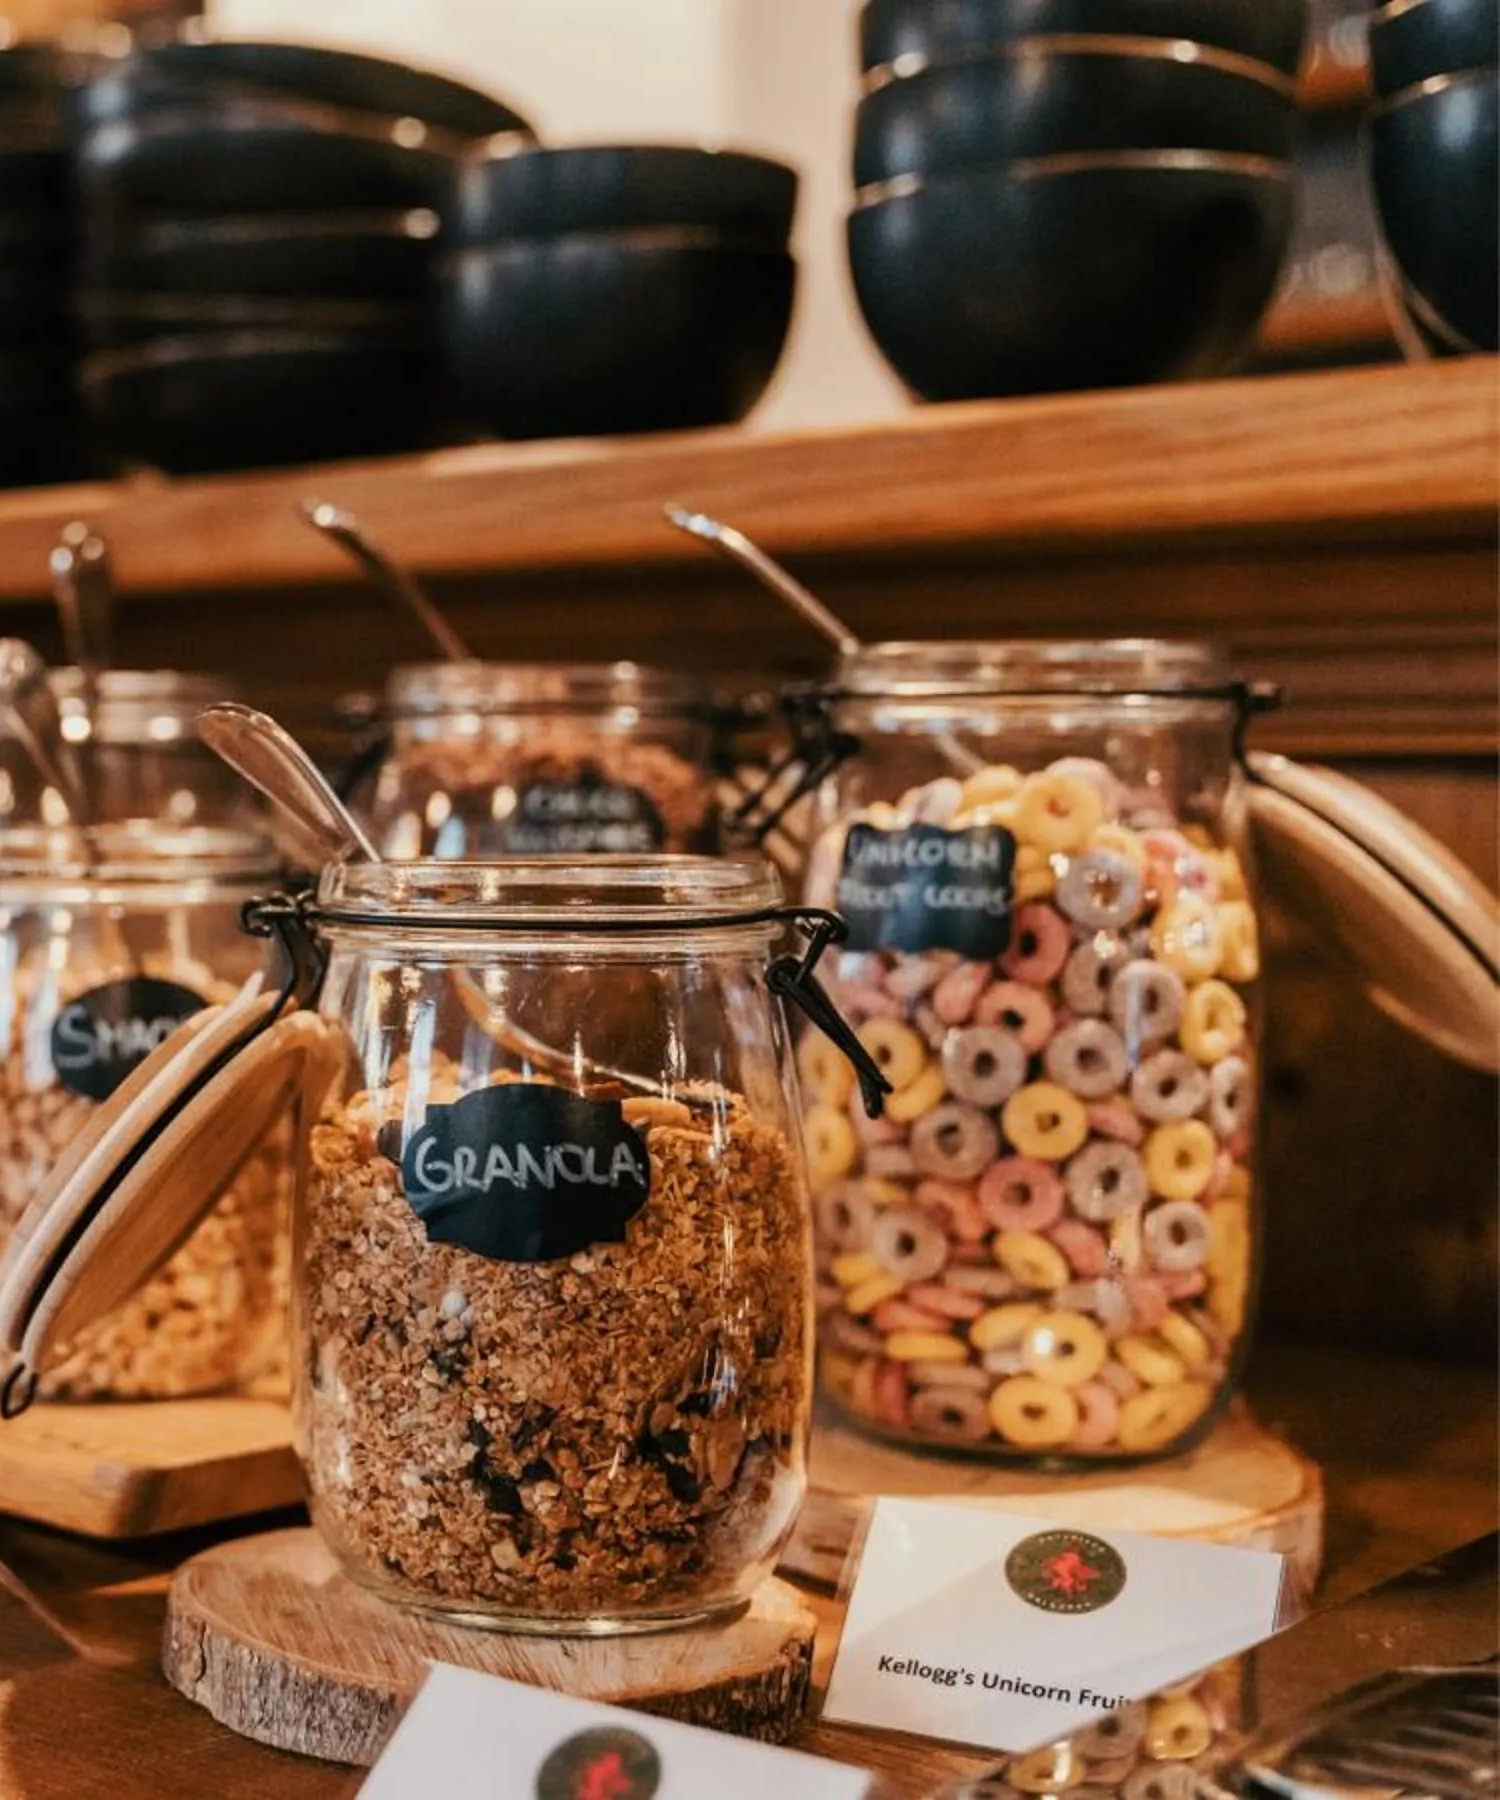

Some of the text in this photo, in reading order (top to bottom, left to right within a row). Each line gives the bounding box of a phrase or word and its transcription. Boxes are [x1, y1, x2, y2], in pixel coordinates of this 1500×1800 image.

[850, 834, 999, 867] UNICORN
[415, 1136, 647, 1193] GRANOLA
[878, 1655, 975, 1687] Kellogg's
[982, 1672, 1072, 1703] Unicorn
